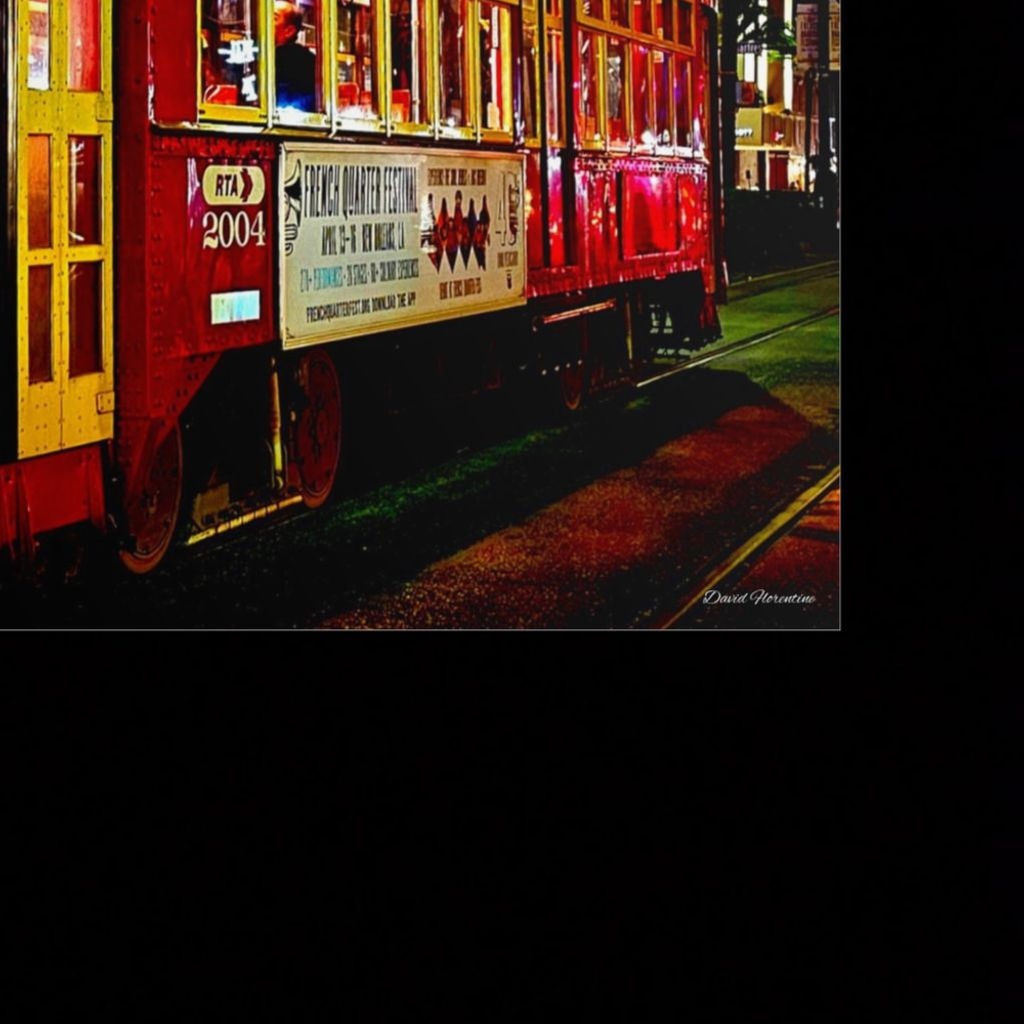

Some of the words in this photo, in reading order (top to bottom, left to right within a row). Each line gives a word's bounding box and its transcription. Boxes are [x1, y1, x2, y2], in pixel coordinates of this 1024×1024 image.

[215, 174, 238, 197] RTA
[304, 164, 340, 219] FRENCH
[342, 165, 381, 222] QUARTER
[383, 166, 418, 215] FESTIVAL
[202, 210, 266, 250] 2004
